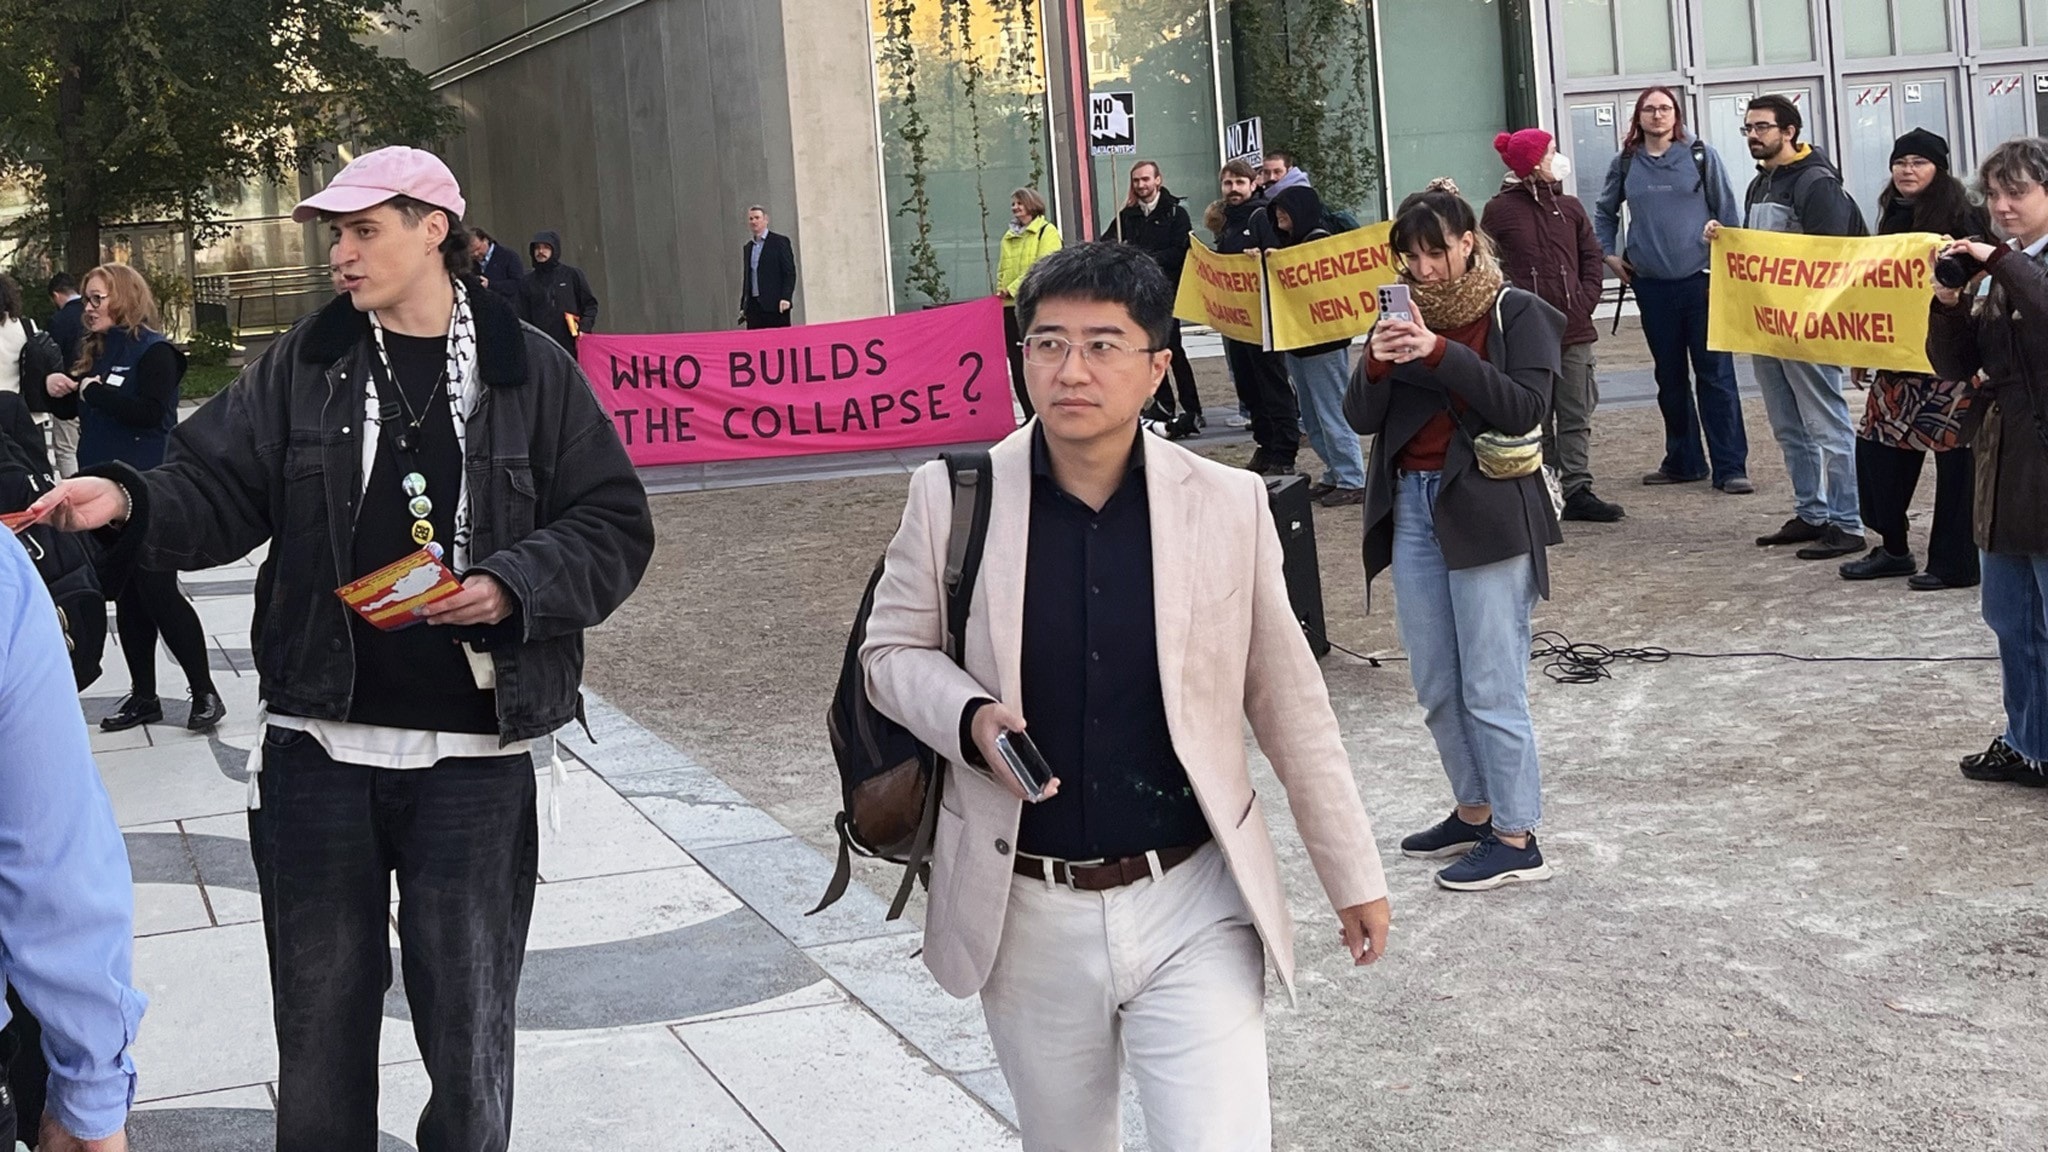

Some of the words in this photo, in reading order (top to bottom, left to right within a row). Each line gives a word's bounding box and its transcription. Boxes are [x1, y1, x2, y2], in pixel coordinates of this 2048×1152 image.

[1093, 98, 1113, 114] NO
[1093, 115, 1109, 130] AI
[1227, 124, 1243, 158] NO
[1246, 118, 1261, 152] AI
[1726, 251, 1926, 289] RECHENZENTREN?
[1309, 294, 1359, 325] NEIN,
[1753, 305, 1799, 344] NEIN,
[1804, 311, 1896, 344] DANKE!
[611, 354, 701, 390] WHO
[729, 338, 888, 388] BUILDS
[614, 407, 697, 446] THE
